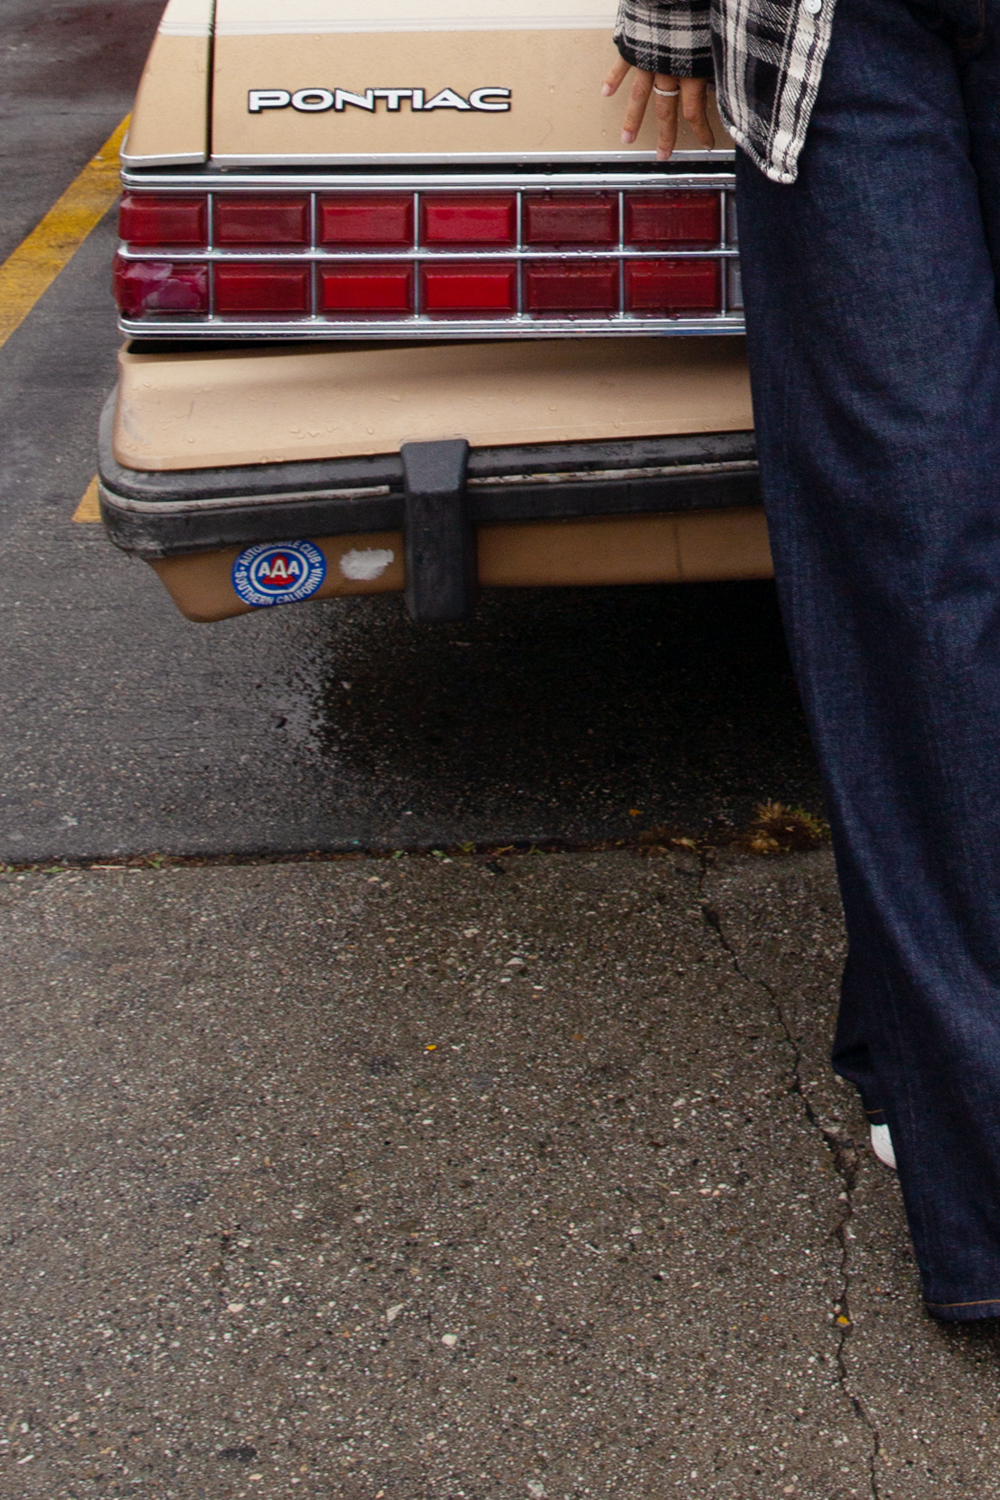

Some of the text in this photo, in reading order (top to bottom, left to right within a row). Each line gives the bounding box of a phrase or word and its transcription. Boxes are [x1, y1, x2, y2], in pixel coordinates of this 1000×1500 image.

[248, 87, 511, 113] PONTIAC
[300, 543, 322, 564] CLUB
[257, 559, 300, 579] AAA
[234, 567, 324, 605] SOUTHERN CALIFORNIA
